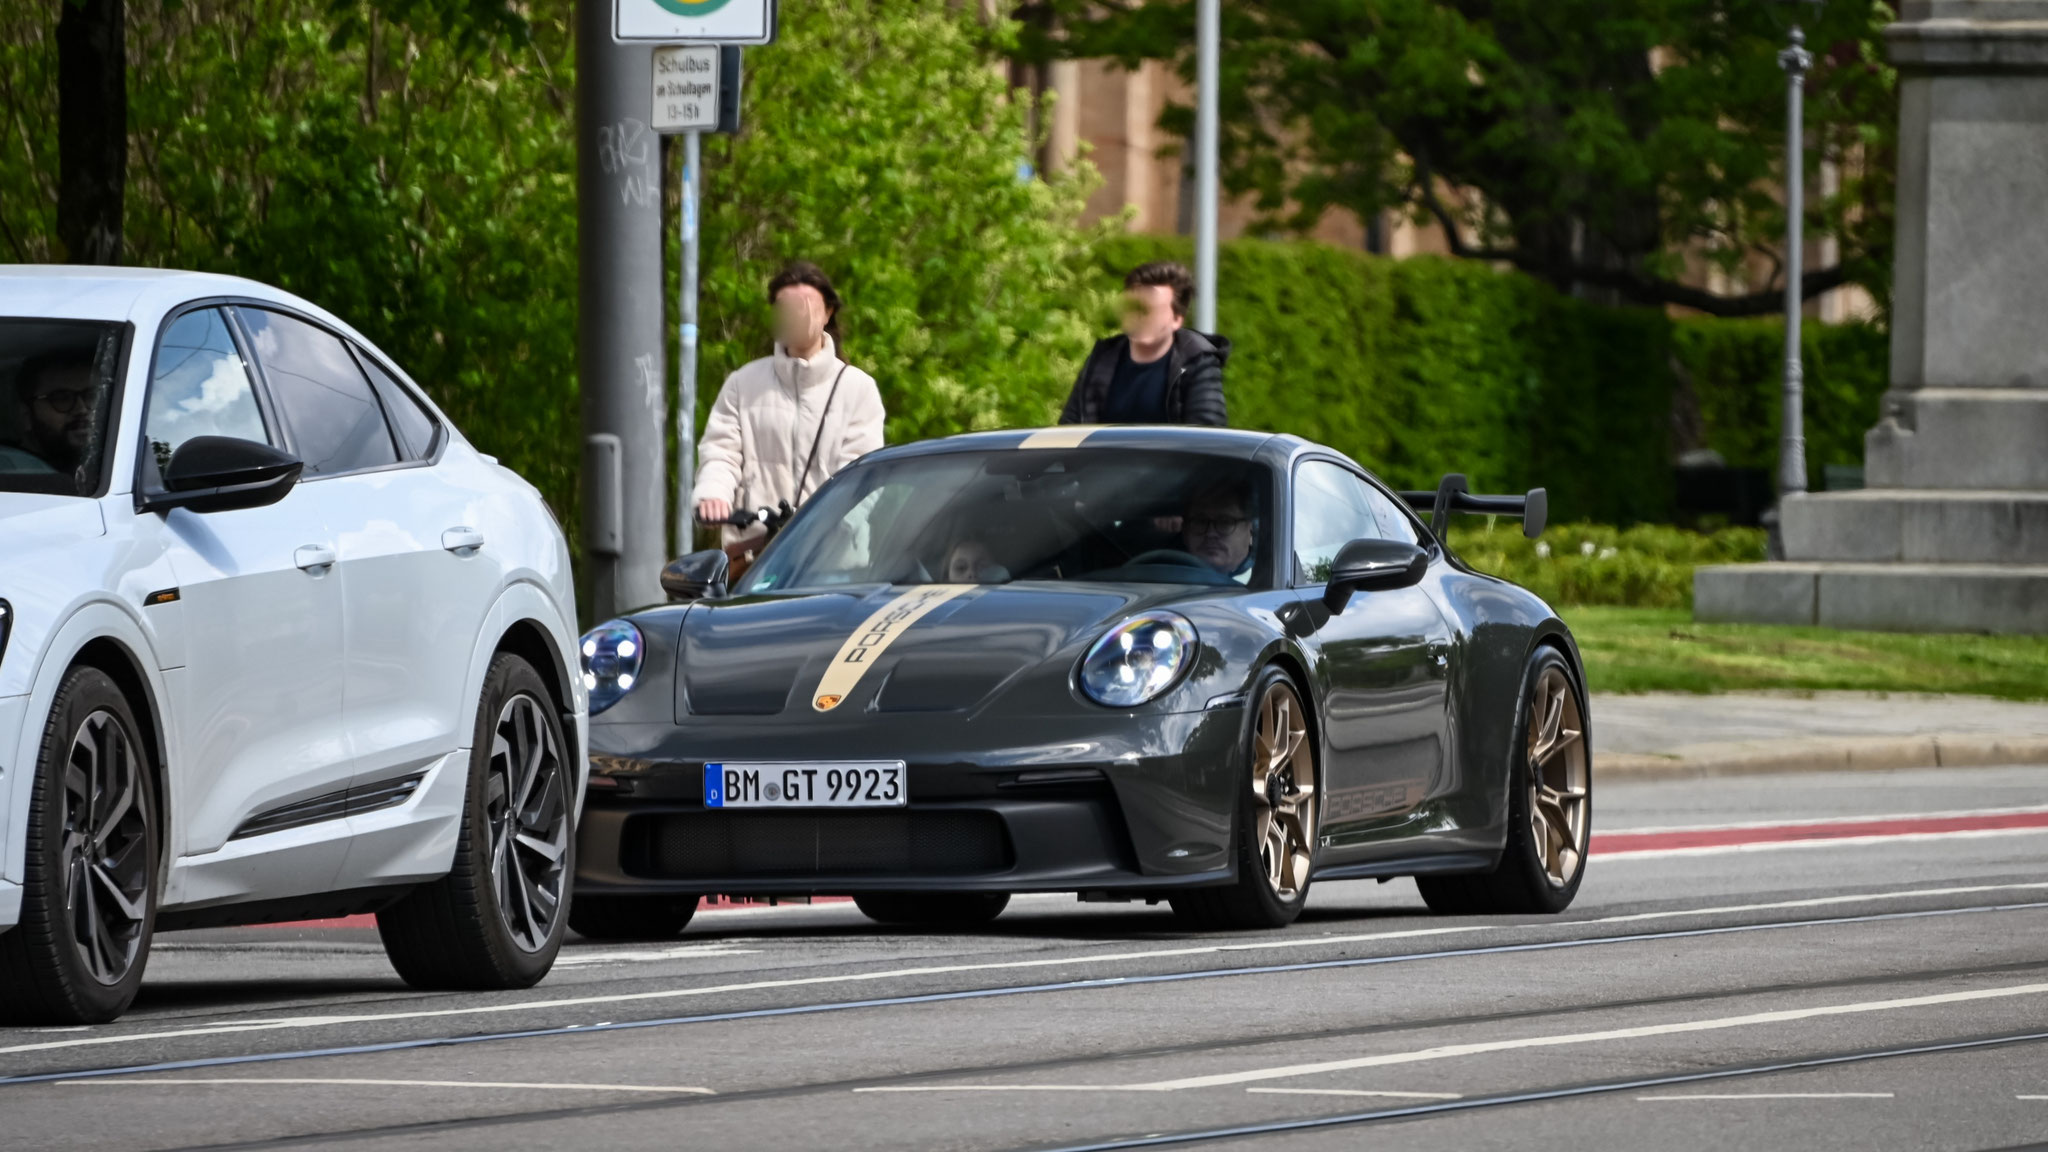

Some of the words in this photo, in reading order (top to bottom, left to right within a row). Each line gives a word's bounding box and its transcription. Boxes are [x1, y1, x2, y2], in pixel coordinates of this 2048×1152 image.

[658, 56, 710, 73] Schulbus
[656, 84, 665, 97] an
[667, 81, 711, 98] Schultagen
[844, 589, 947, 662] PORSCHE
[711, 790, 718, 799] D
[724, 769, 760, 802] BM
[782, 769, 818, 801] GT
[826, 768, 899, 801] 9923
